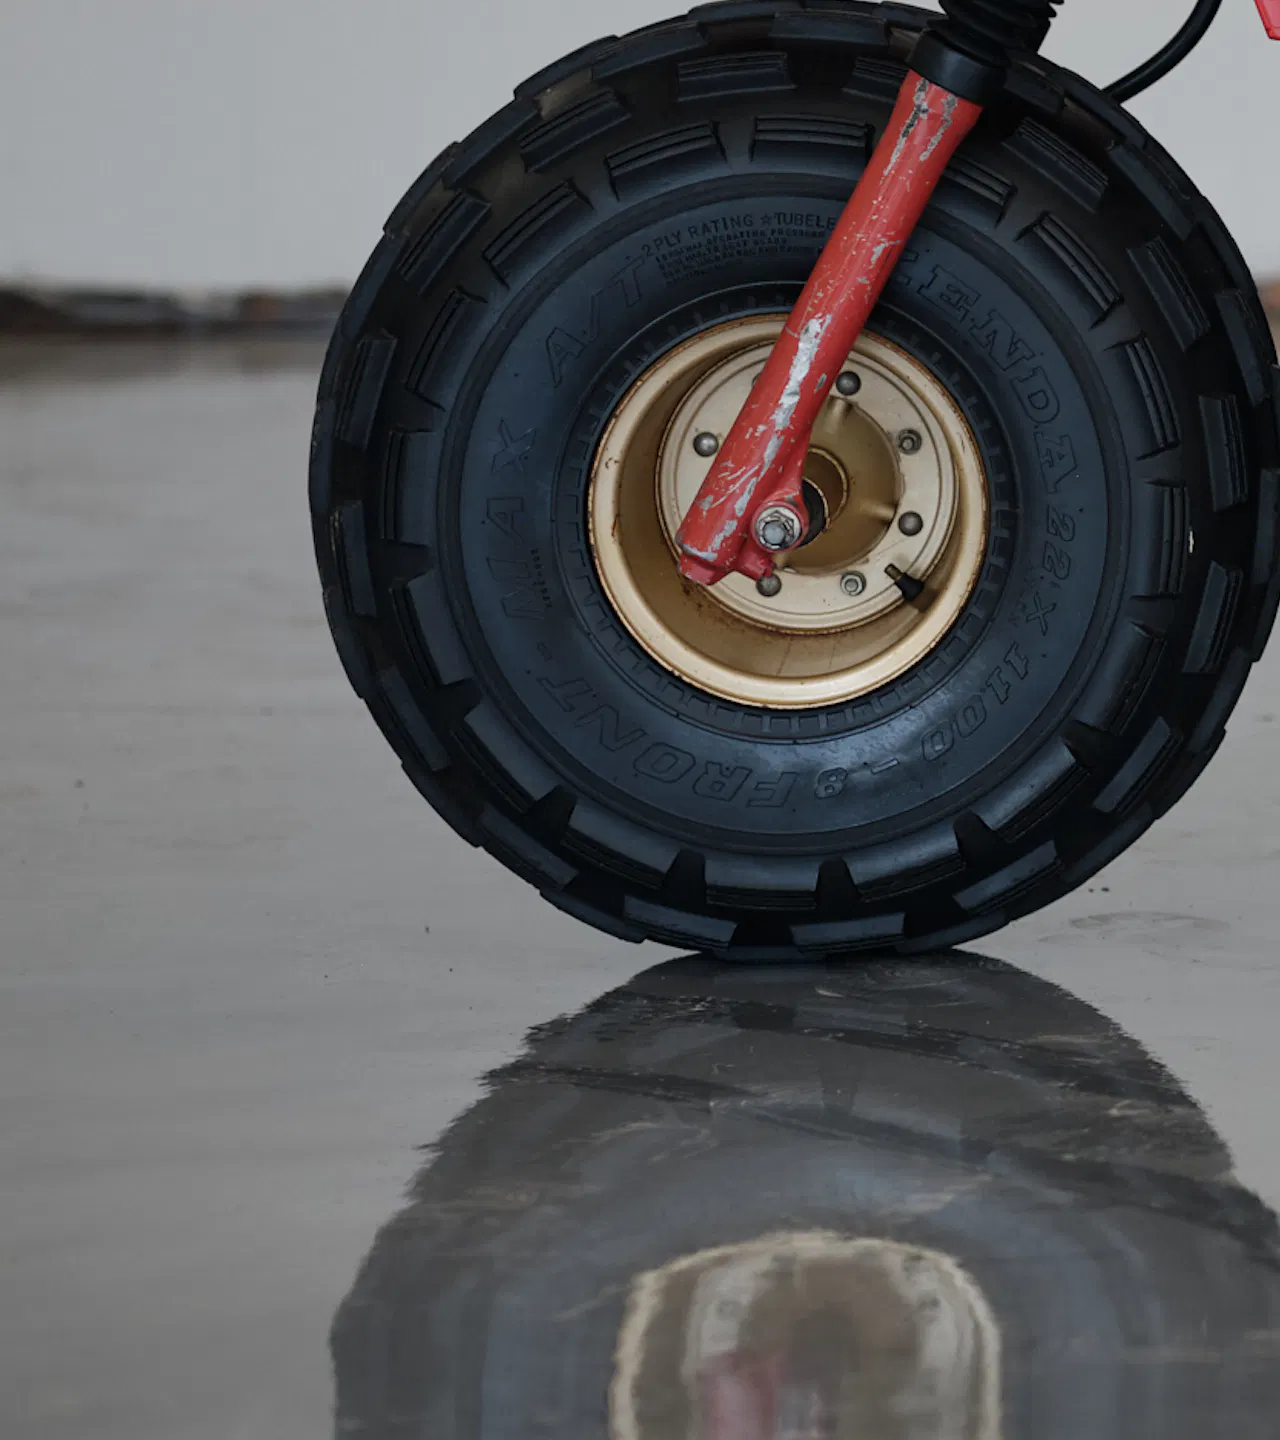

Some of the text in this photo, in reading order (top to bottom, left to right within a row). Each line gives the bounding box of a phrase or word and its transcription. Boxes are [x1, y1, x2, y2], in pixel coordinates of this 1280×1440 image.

[651, 227, 684, 253] PLY
[686, 211, 754, 240] RATING
[773, 211, 836, 231] TUBELE
[538, 661, 799, 811] FRONT
